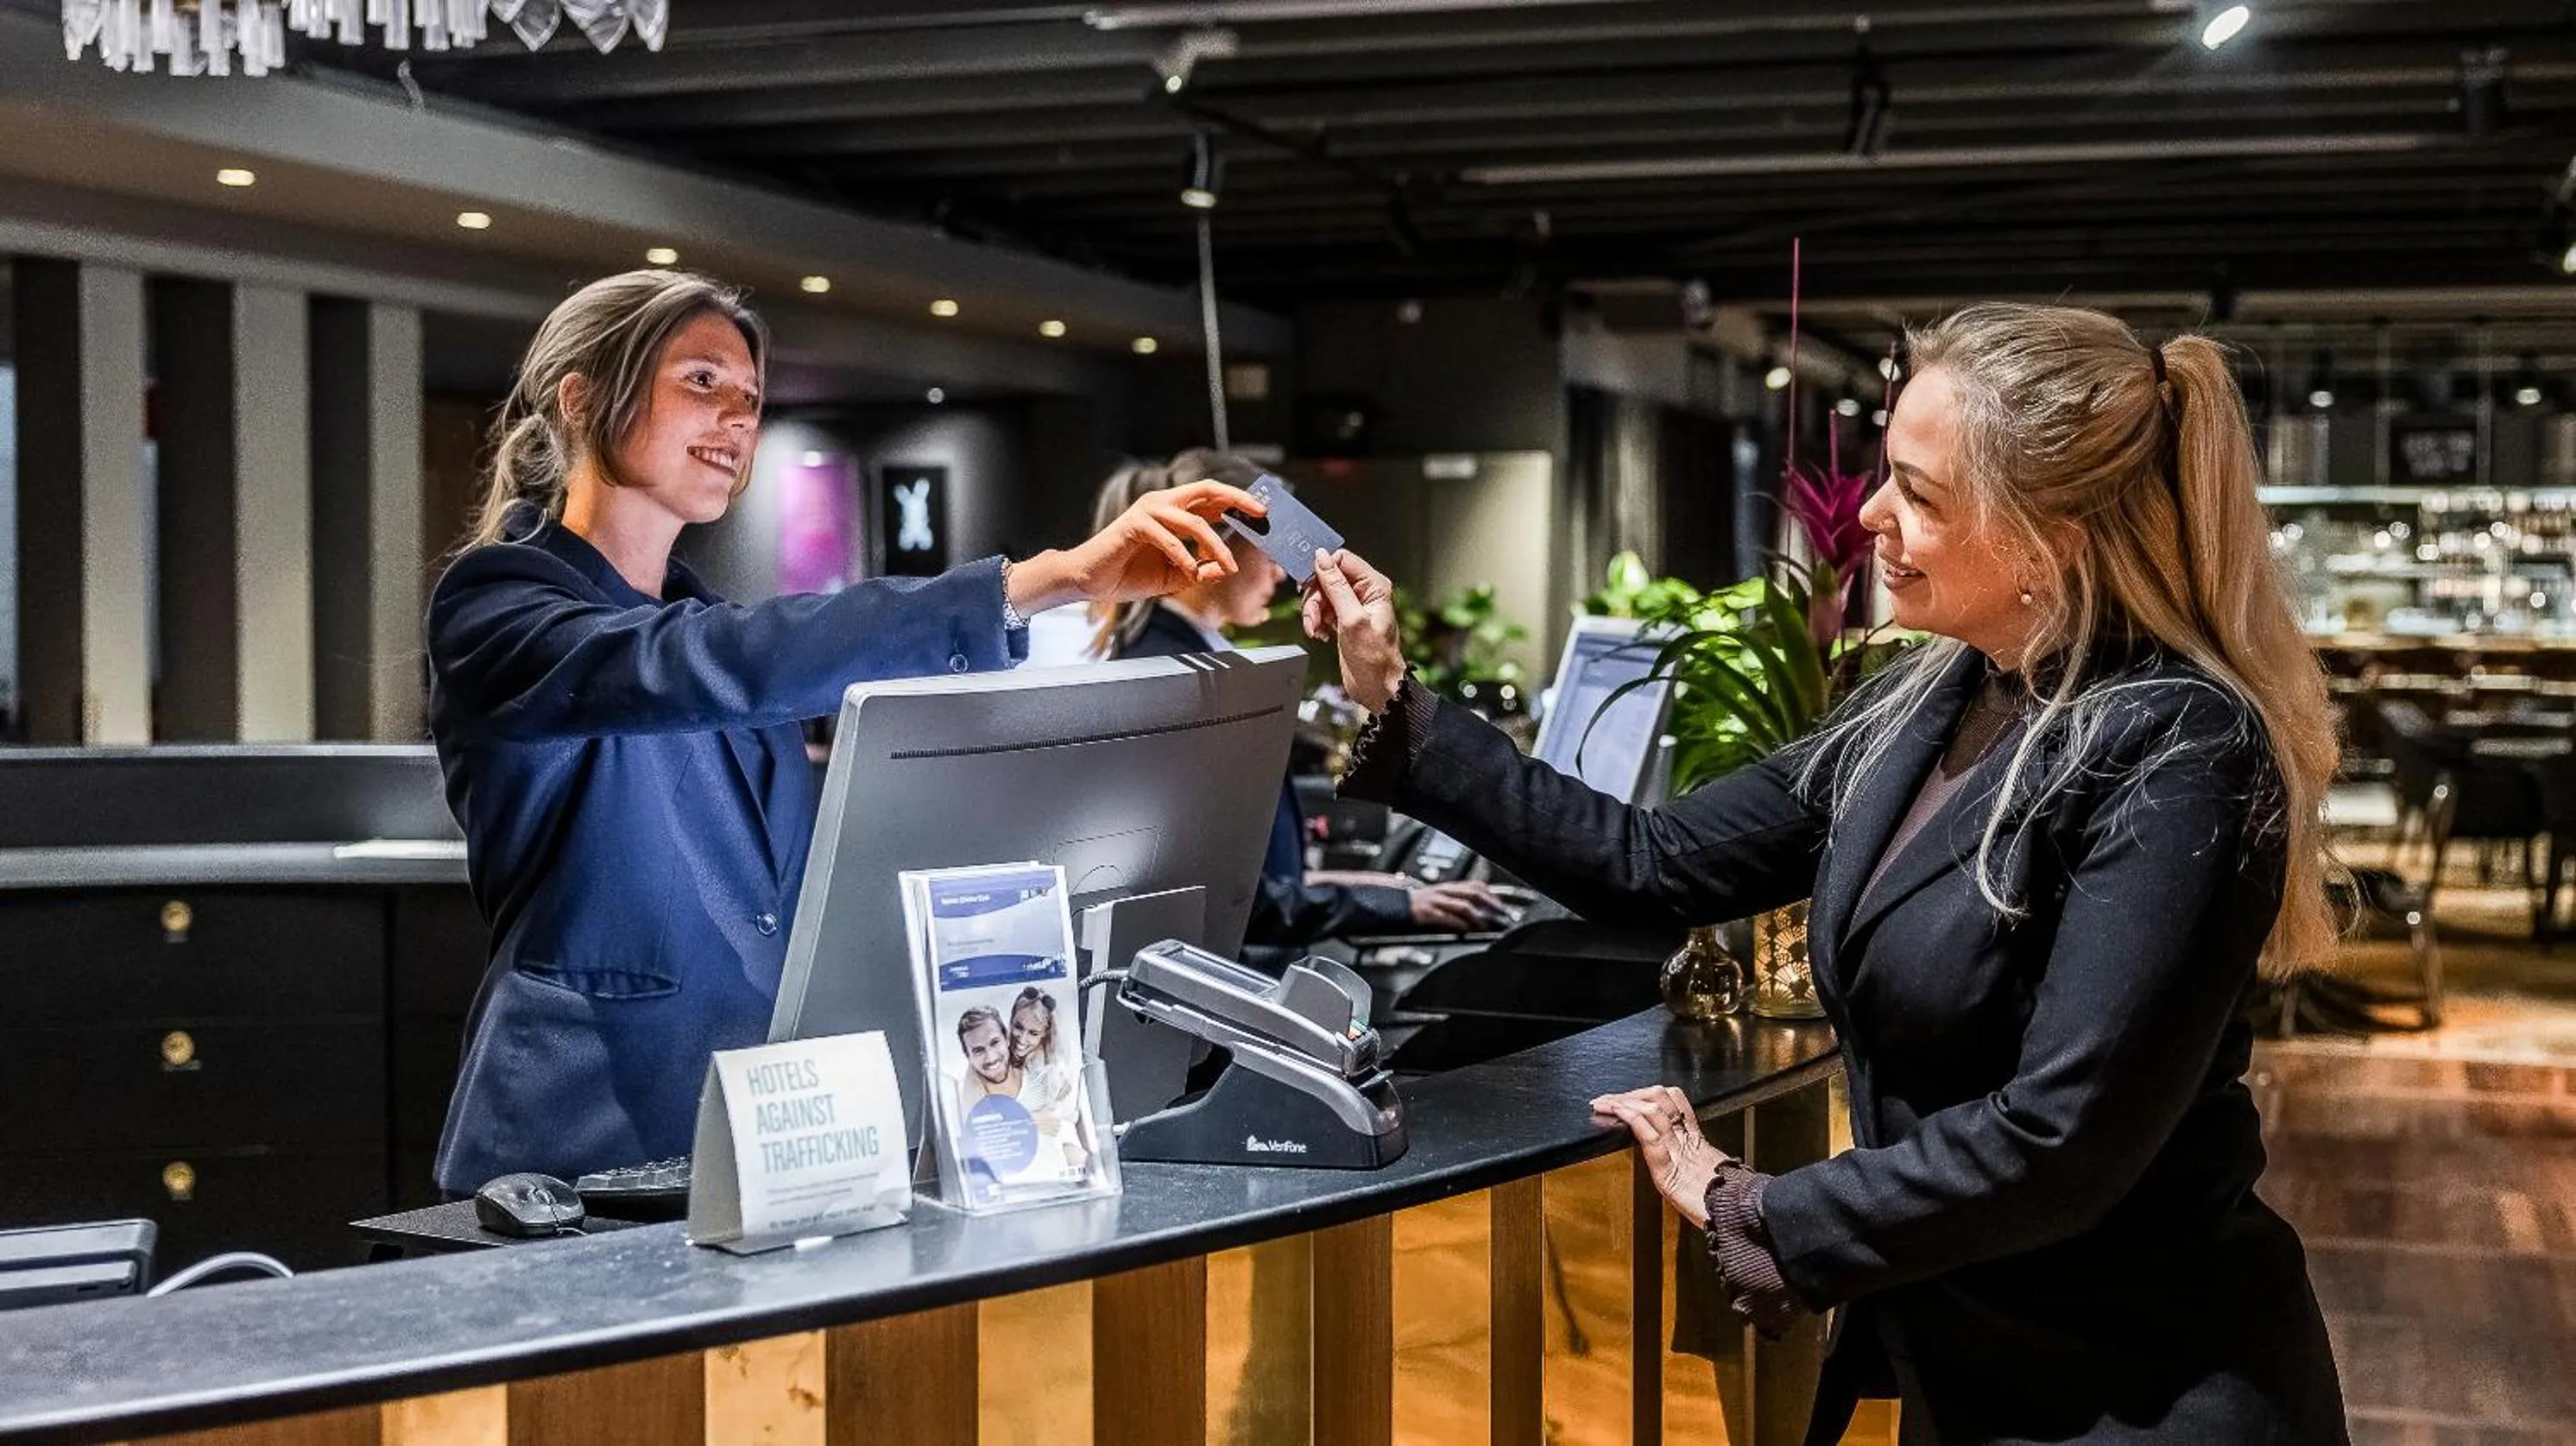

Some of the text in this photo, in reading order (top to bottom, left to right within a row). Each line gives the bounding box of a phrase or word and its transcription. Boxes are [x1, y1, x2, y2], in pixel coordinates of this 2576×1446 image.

[746, 1058, 819, 1096] HOTELS
[755, 1094, 836, 1134] AGAINST
[760, 1126, 880, 1173] TRAFFICKING
